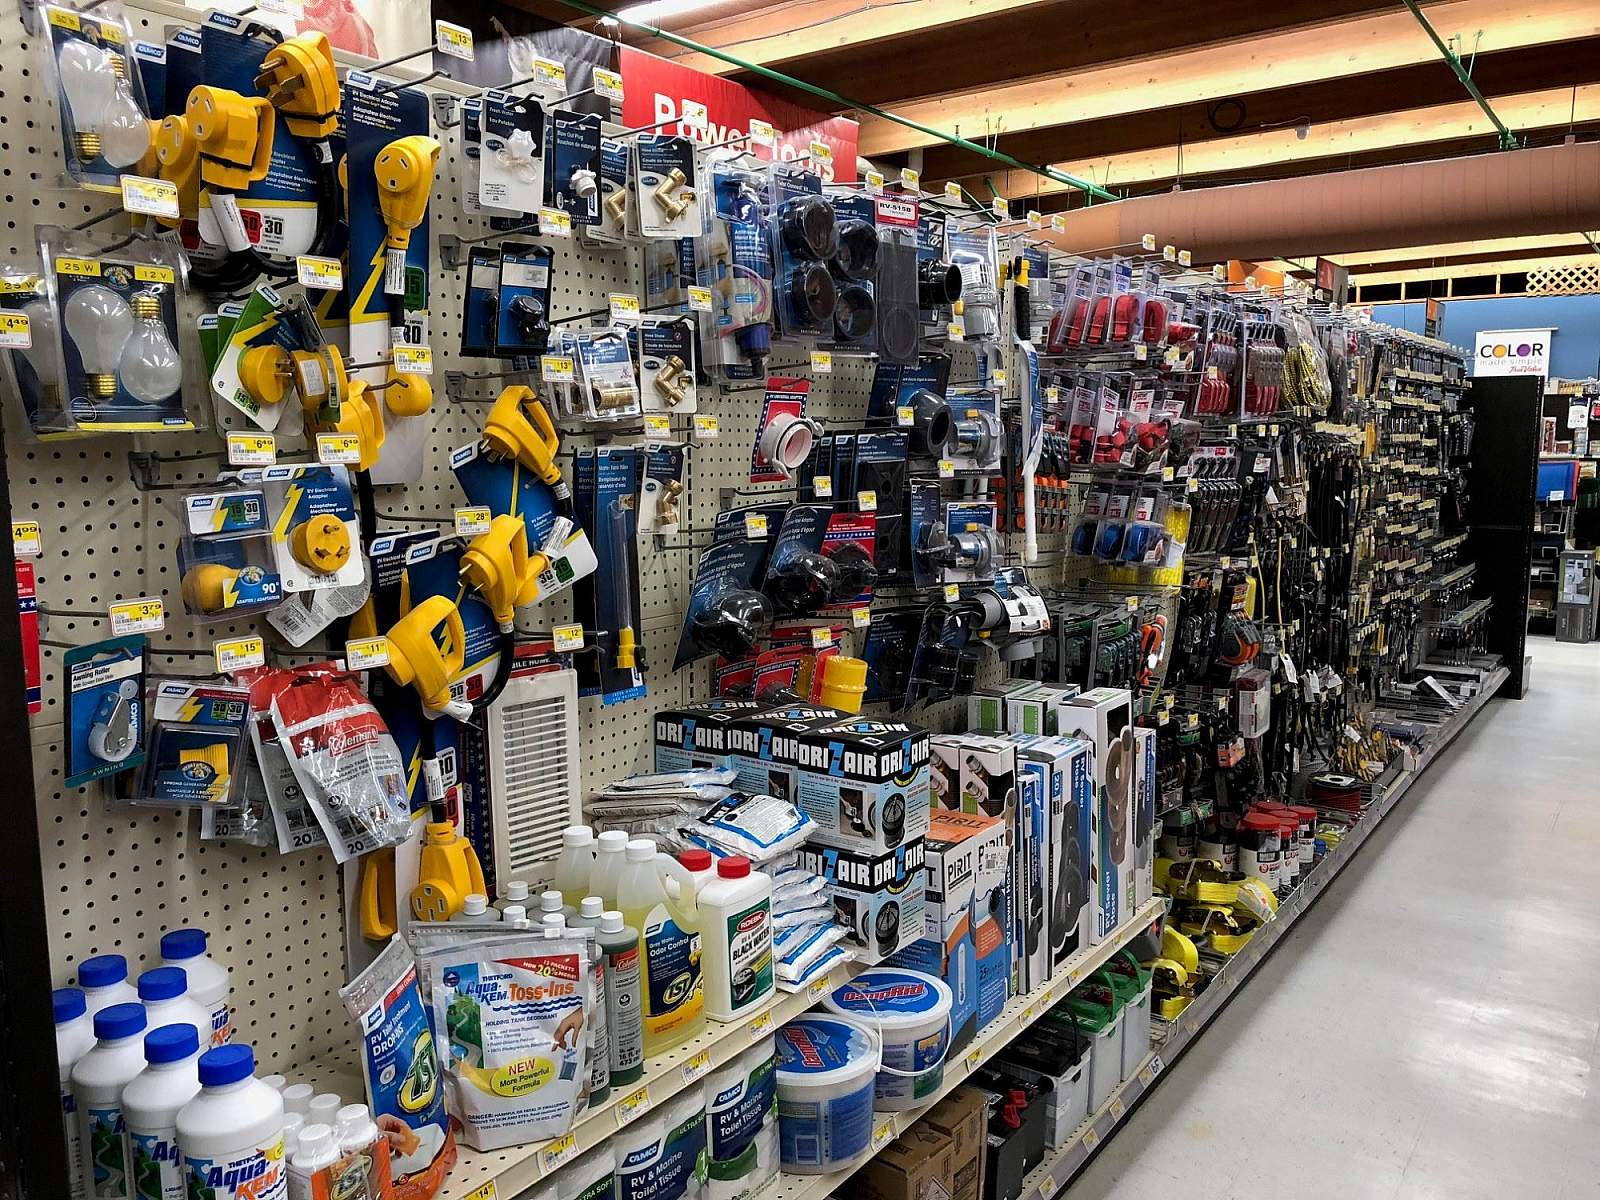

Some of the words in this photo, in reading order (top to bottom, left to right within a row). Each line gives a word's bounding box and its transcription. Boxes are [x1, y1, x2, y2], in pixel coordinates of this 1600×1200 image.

[264, 219, 283, 235] 30
[82, 264, 94, 273] W
[143, 270, 156, 279] 12
[160, 272, 167, 280] V
[4, 282, 21, 290] 25
[1480, 343, 1543, 358] COLOR
[246, 503, 258, 513] 30
[511, 659, 527, 669] BILE
[73, 672, 94, 682] Awning
[94, 666, 110, 678] Roller
[450, 684, 464, 697] 30
[213, 703, 226, 713] 30
[229, 704, 242, 714] 30
[934, 815, 988, 829] PIRIT
[215, 825, 229, 836] 20
[293, 834, 312, 847] 20
[348, 840, 364, 854] 20
[948, 852, 972, 883] PIRIT
[650, 943, 668, 957] Odor
[667, 936, 689, 951] Control
[733, 939, 752, 960] BLACK
[482, 973, 513, 982] THETFORD
[481, 991, 508, 1006] KEM
[509, 981, 575, 1002] Toss-Ins
[485, 1017, 510, 1027] HOLDING
[510, 1016, 526, 1024] TANK
[526, 1013, 558, 1022] DEODORANT
[371, 1032, 383, 1045] RV
[508, 1059, 536, 1076] NEW
[500, 1077, 519, 1089] More
[518, 1066, 551, 1083] Powerful
[512, 1079, 541, 1093] Formula
[719, 1085, 741, 1102] CAMCO
[720, 1112, 733, 1126] RV
[734, 1107, 740, 1118] &
[741, 1090, 764, 1112] Marine
[720, 1120, 742, 1137] Toilet
[742, 1104, 763, 1129] Tissue
[228, 1150, 265, 1169] THETFORD
[629, 1144, 657, 1164] CAMCO
[631, 1175, 647, 1189] RV
[647, 1170, 655, 1181] &
[655, 1150, 683, 1174] Marine
[597, 1178, 614, 1194] SOFT
[631, 1181, 659, 1200] Toilet
[658, 1162, 683, 1191] Tissue
